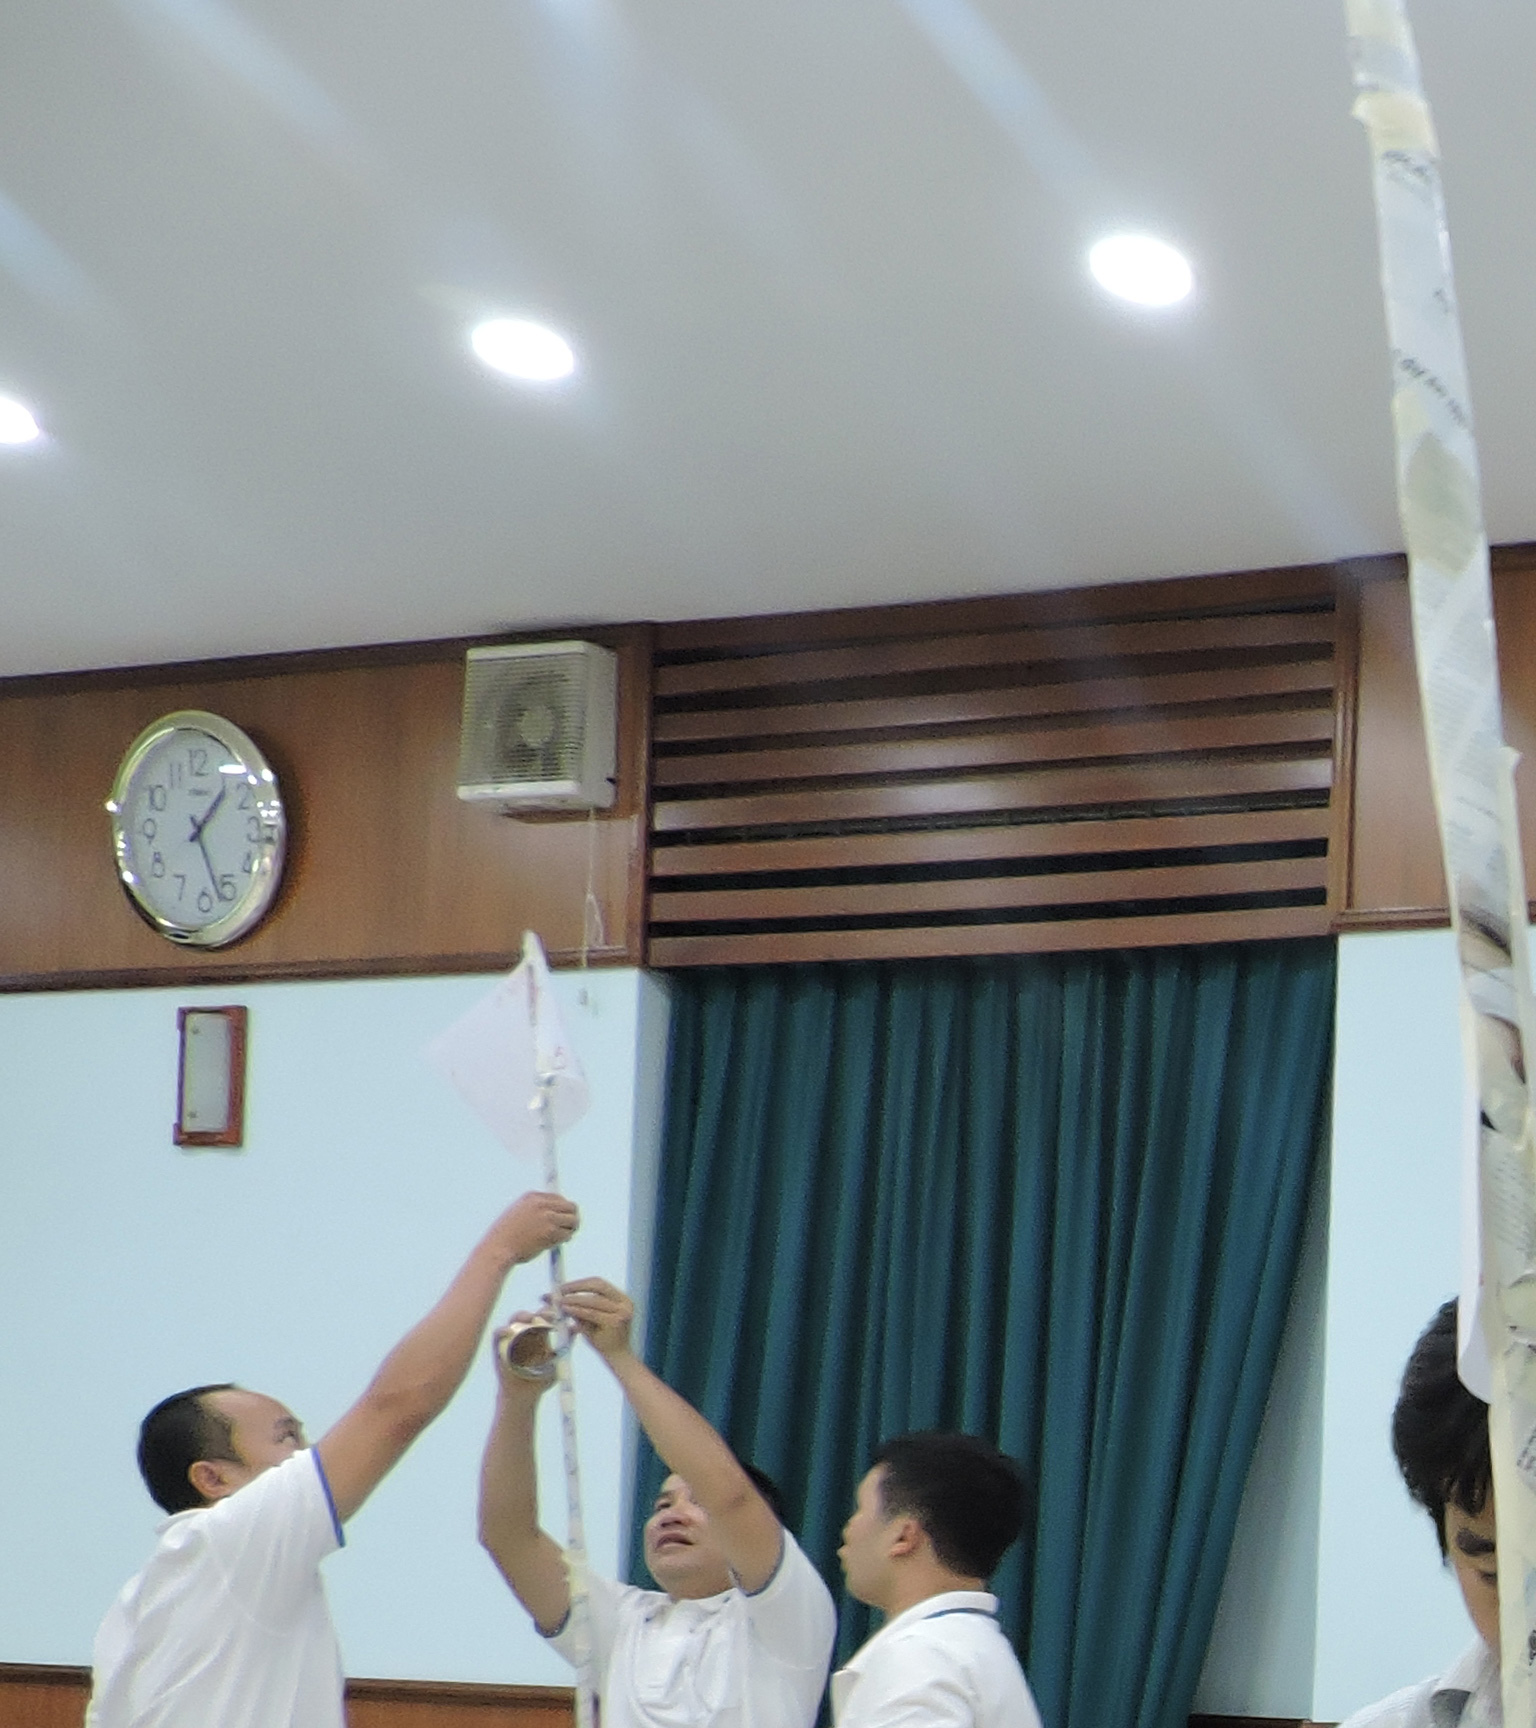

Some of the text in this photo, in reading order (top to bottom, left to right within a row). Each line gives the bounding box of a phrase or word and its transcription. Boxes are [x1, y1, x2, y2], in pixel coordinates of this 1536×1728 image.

[187, 749, 208, 778] 12
[145, 783, 167, 812] 10
[142, 818, 156, 844] 9
[151, 851, 166, 879] 8
[172, 875, 187, 902] 7
